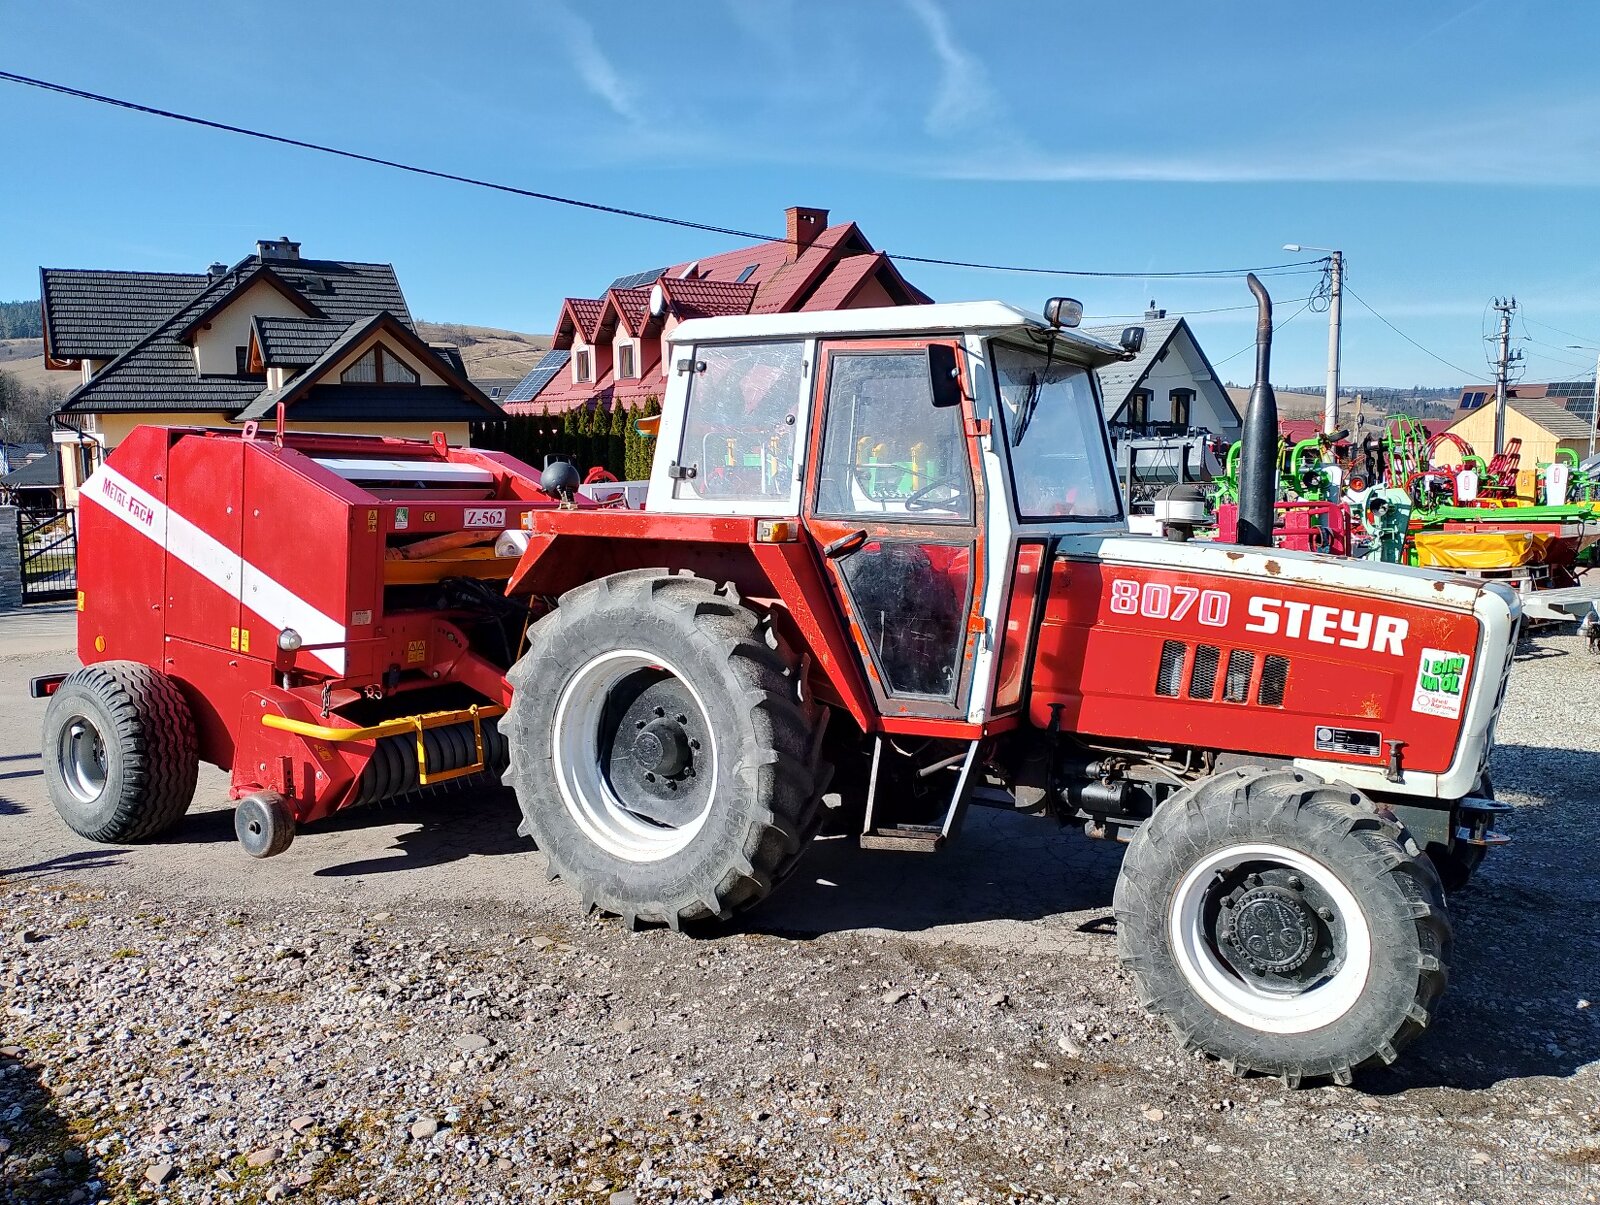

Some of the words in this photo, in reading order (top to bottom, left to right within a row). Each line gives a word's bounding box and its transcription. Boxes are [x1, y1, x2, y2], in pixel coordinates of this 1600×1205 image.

[467, 510, 503, 525] Z-562
[1110, 578, 1231, 628] 8070
[1245, 596, 1409, 656] STEYR
